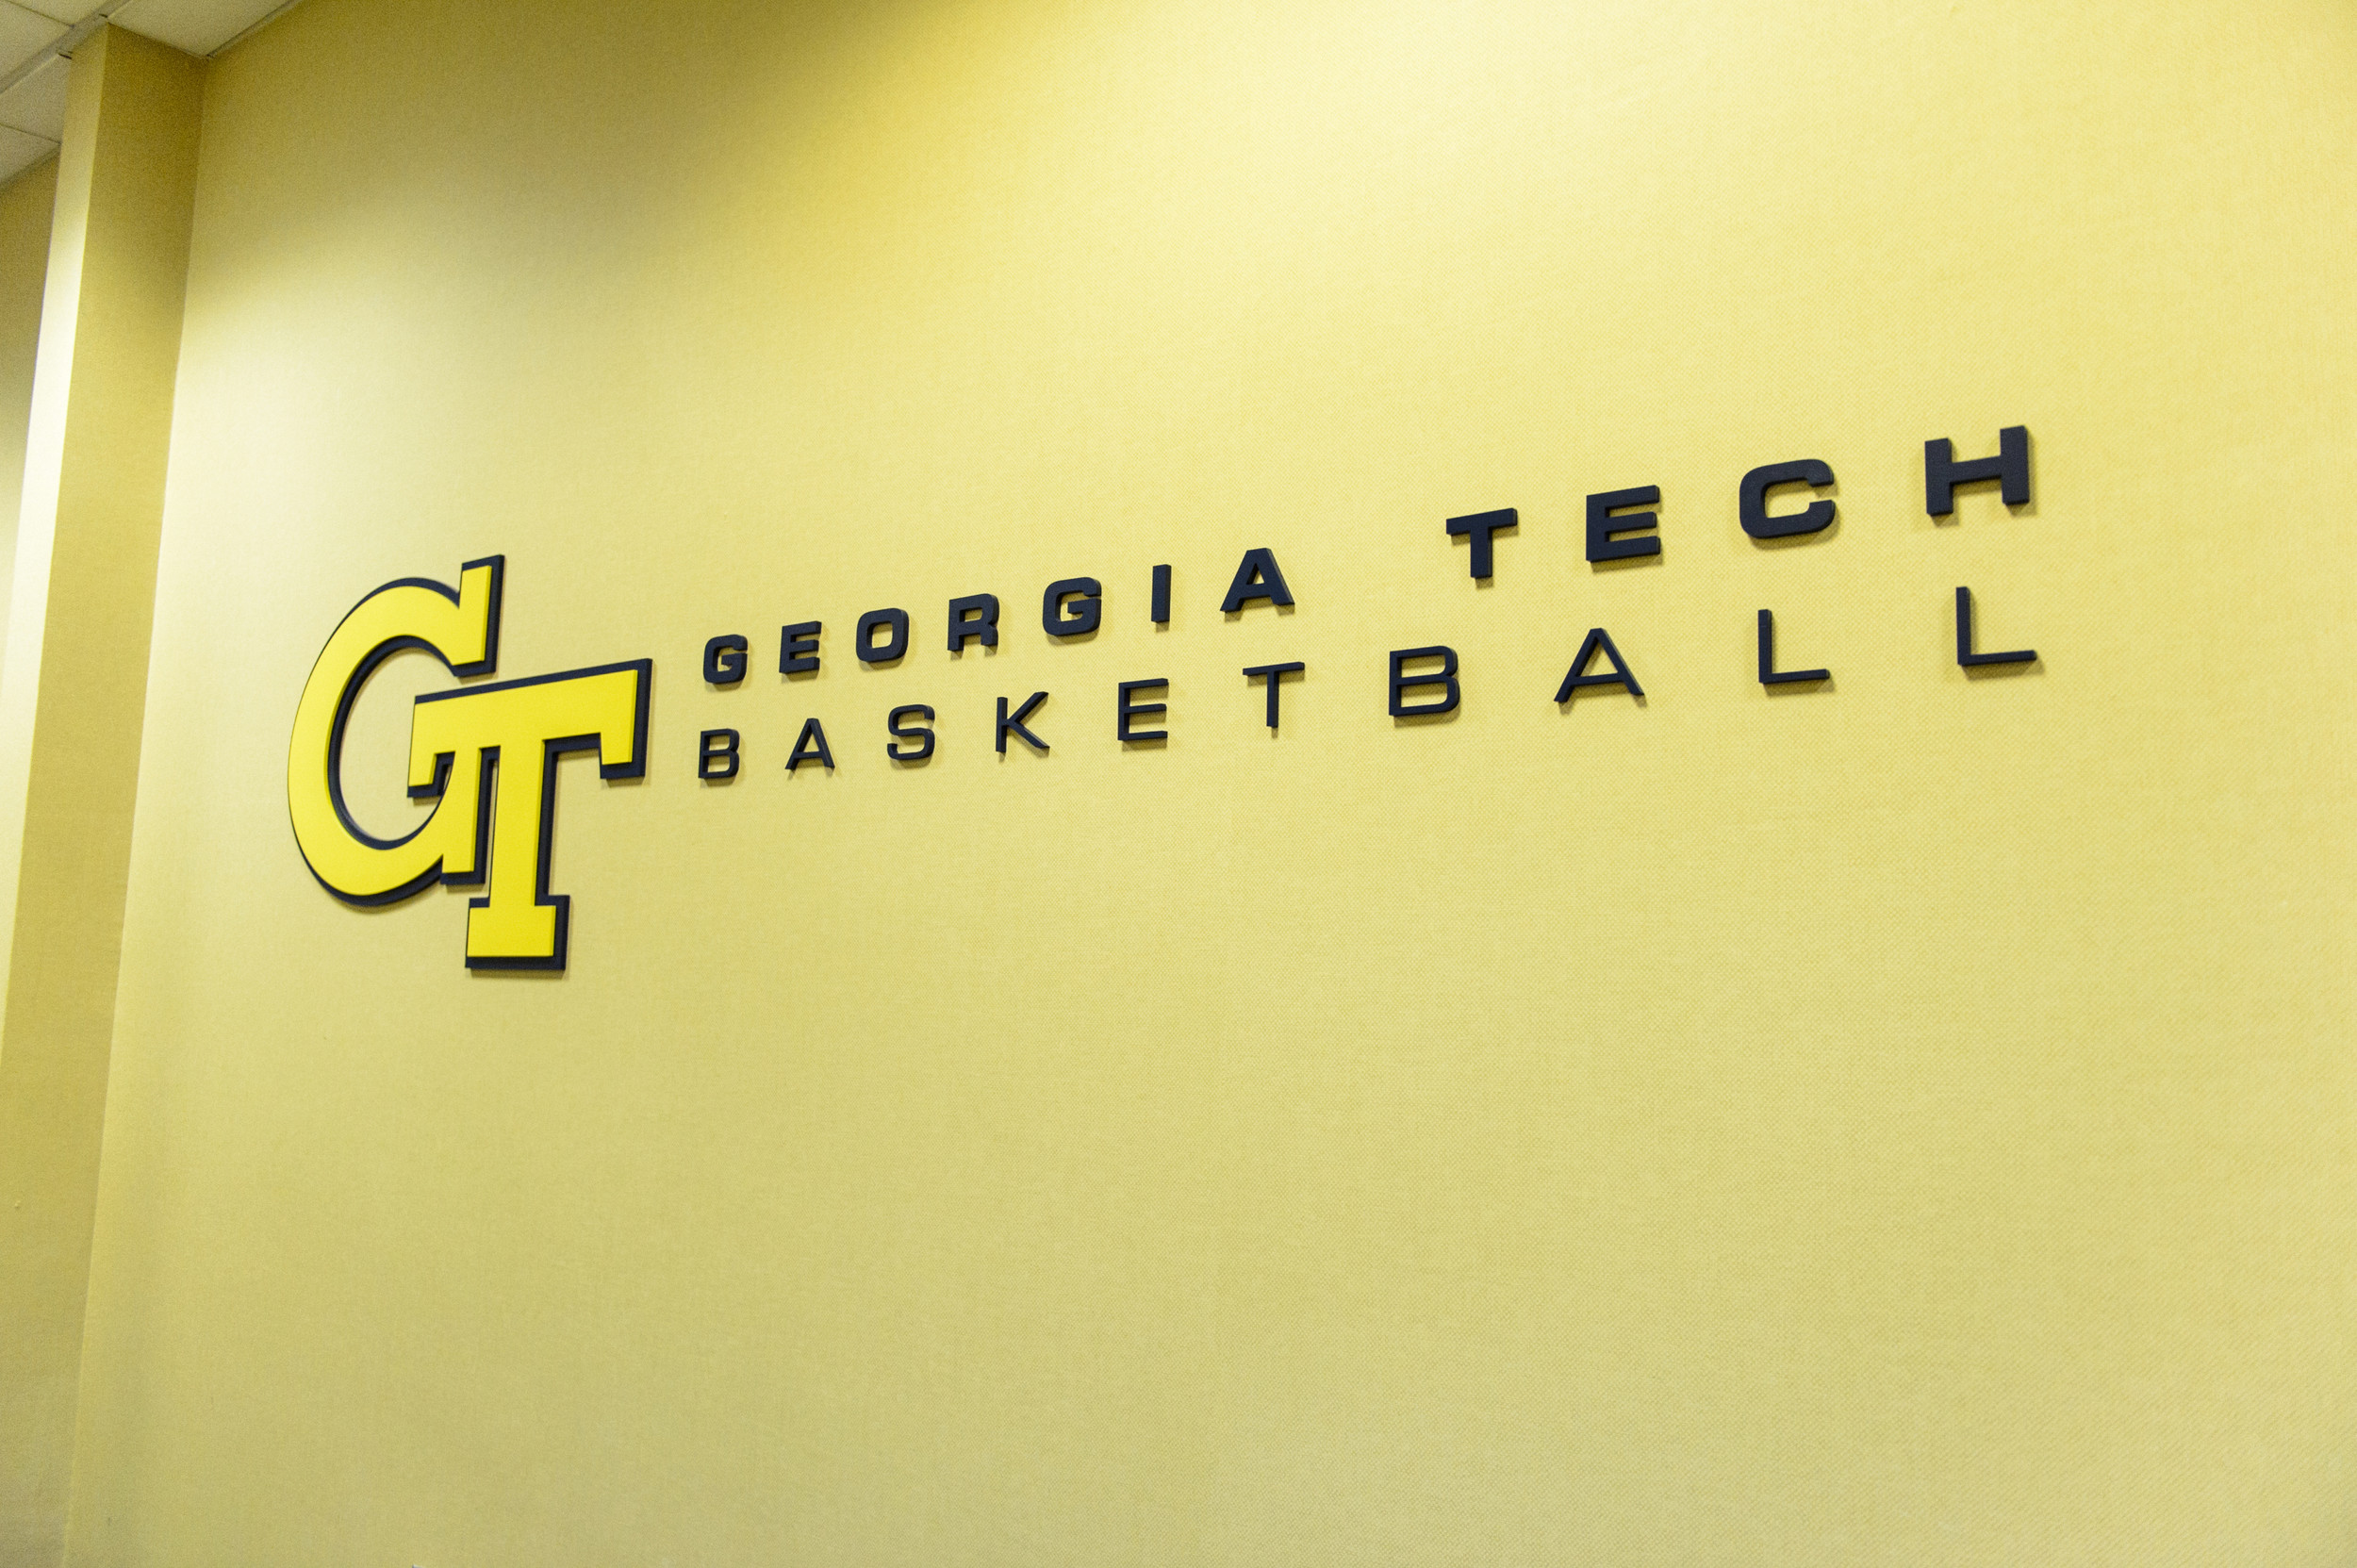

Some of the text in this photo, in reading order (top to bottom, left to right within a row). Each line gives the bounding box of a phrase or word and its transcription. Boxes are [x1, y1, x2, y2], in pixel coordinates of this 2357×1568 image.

[699, 586, 2037, 782] BASKETBALL
[702, 425, 2031, 687] GEORGIA TECH
[287, 553, 653, 974] GT
